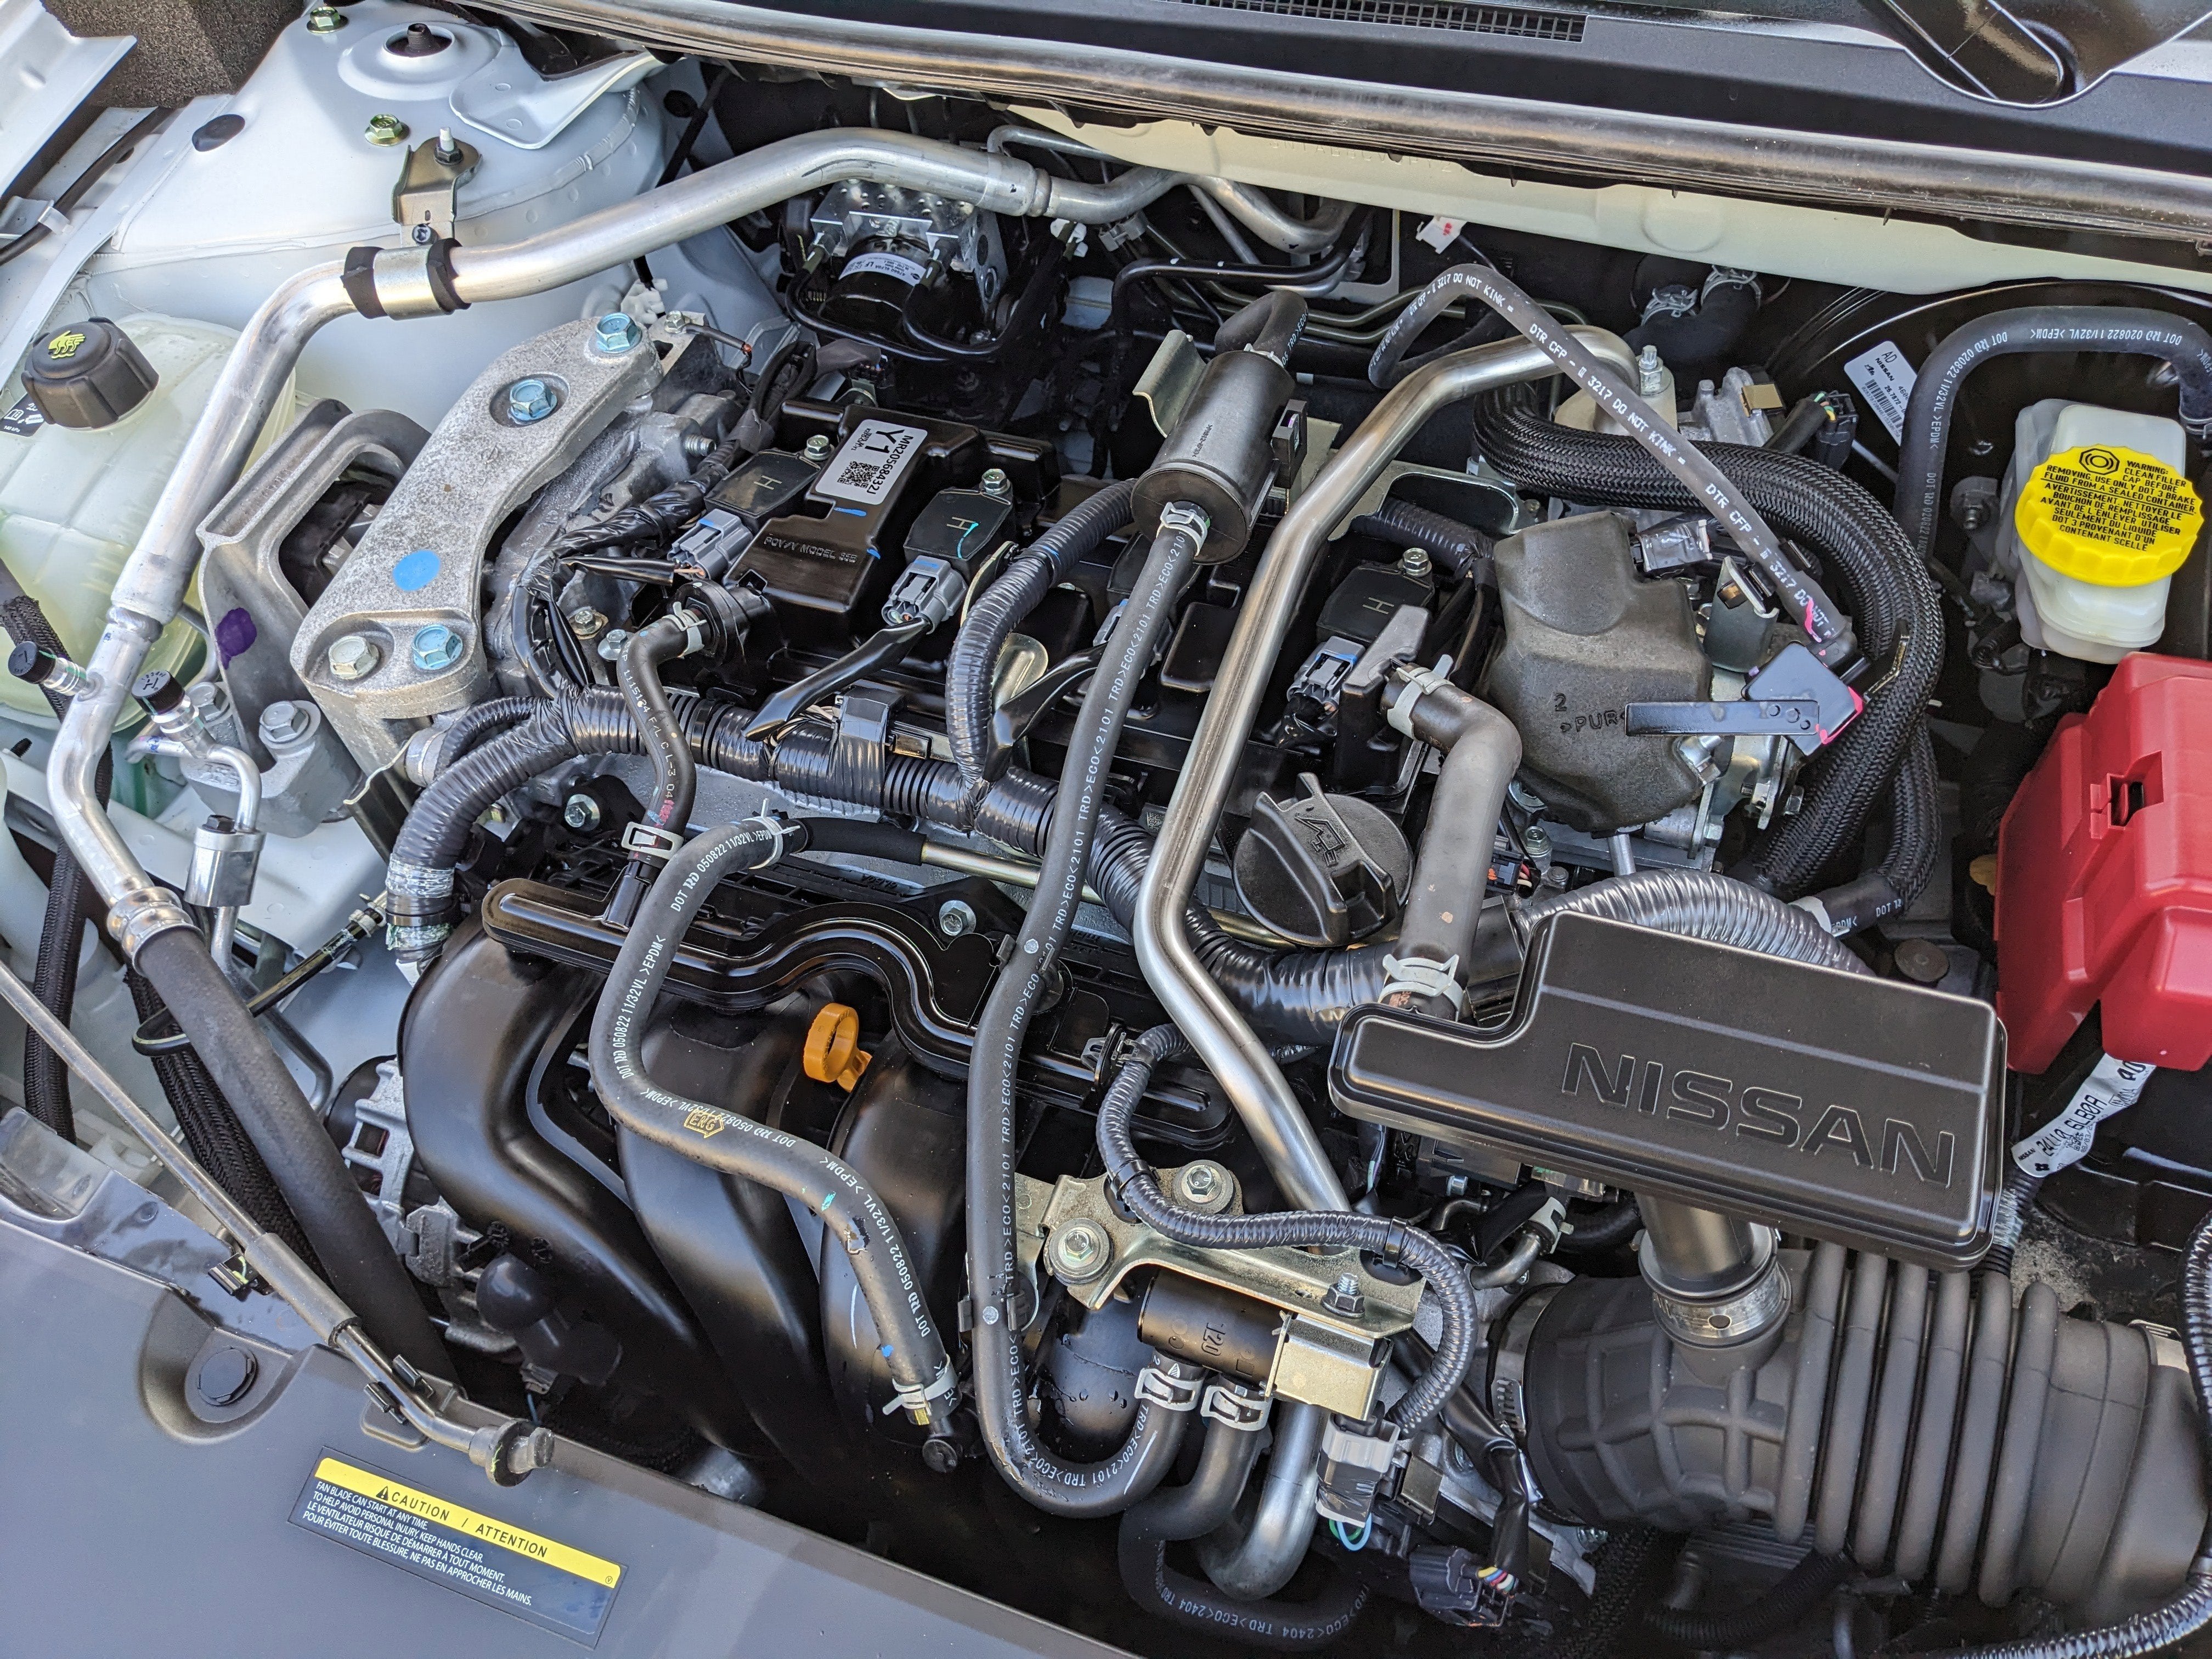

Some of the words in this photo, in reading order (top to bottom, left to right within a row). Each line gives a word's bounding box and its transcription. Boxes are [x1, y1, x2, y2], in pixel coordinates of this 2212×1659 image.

[1437, 274, 1451, 289] 3217
[1453, 273, 1463, 283] DO
[1465, 275, 1482, 290] NOT
[1483, 285, 1505, 307] KINK
[1992, 332, 2007, 346] DOT
[2030, 329, 2064, 339] >EPDM<
[2107, 329, 2143, 340] 020822
[2163, 332, 2182, 346] DOT
[1875, 357, 1894, 381] NISSAN
[1881, 351, 1898, 364] AD
[1947, 349, 1974, 378] 020822
[1530, 324, 1548, 343] DTR
[1549, 341, 1567, 358] CFP
[1588, 376, 1613, 400] 3217
[1612, 398, 1627, 414] DO
[1627, 412, 1649, 432] NOT
[1648, 430, 1676, 457] KINK
[864, 430, 904, 454] Y1
[1930, 415, 1942, 449] >EPDM<
[866, 435, 914, 496] MR20568432J
[1926, 473, 1937, 489] DOT
[2124, 467, 2154, 481] CLEAN
[2155, 474, 2186, 488] FILLER
[2044, 472, 2069, 483] FLUID
[2072, 478, 2096, 490] FROM
[2108, 487, 2143, 501] SEALED
[2145, 495, 2198, 514] CONTAINER.
[2095, 476, 2112, 486] USE
[2112, 479, 2135, 491] ONLY
[2137, 486, 2155, 496] DOT
[2165, 492, 2195, 505] BRAKE
[2122, 475, 2140, 484] CAP
[2145, 479, 2178, 493] BEFORE
[2040, 496, 2070, 509] AVANT
[2074, 504, 2085, 512] DE
[2087, 507, 2136, 524] L'ENLEVER
[2141, 520, 2181, 535] UTILISER
[2052, 492, 2092, 506] BOUCHON
[2094, 501, 2105, 510] DE
[2107, 504, 2170, 525] REMPLISSAGE
[2053, 507, 2106, 525] SEULEMENT
[2109, 520, 2121, 528] DU
[2123, 523, 2157, 537] LIQUIDE
[2123, 500, 2168, 517] NETTOYER
[2170, 511, 2182, 521] LE
[1705, 483, 1729, 509] DTR
[1729, 510, 1752, 532] CFP
[1769, 560, 1797, 588] 3217
[2052, 514, 2069, 524] DOT
[2079, 521, 2132, 539] PROVENANT
[2134, 534, 2155, 545] D'UN
[2058, 524, 2111, 543] CONTENANT
[2113, 535, 2148, 551] SCELLÉ
[799, 543, 837, 559] MODEL
[1146, 530, 1187, 610] TRD>ECO<2101
[1109, 614, 1151, 706] TRD>ECO<2101
[1555, 693, 1567, 709] 2
[1078, 708, 1114, 821] TRD>ECO<2101
[671, 890, 688, 912] DOT
[697, 844, 727, 872] 050822
[725, 832, 754, 849] 11/32VL
[1052, 831, 1085, 932] TRD>ECO<2101
[1875, 902, 1891, 917] DOT
[640, 935, 666, 975] >EPDM<
[621, 979, 647, 1014] 11/32VL
[613, 1015, 630, 1048] 050822
[617, 1064, 634, 1079] DOT
[640, 1088, 678, 1108] >EPDM<
[1001, 1036, 1015, 1143] TRD>ECO<2101
[689, 1114, 718, 1131] ENG
[1561, 1042, 1959, 1188] NISSAN
[772, 1134, 797, 1148] DOT
[2018, 1148, 2036, 1161] NISSAN
[820, 1156, 865, 1195] >EPDM<
[863, 1194, 896, 1244] 11/32VL
[1002, 1153, 1014, 1286] TRD>ECO<2101
[889, 1244, 913, 1291] 050822
[915, 1313, 931, 1338] DOT
[1201, 1323, 1226, 1356] 120
[1092, 1404, 1149, 1485] TRD>ECO<2101
[316, 1481, 330, 1493] FAN
[330, 1486, 352, 1502] BLADE
[351, 1494, 367, 1507] CAN
[366, 1499, 387, 1515] START
[386, 1507, 397, 1518] AT
[396, 1510, 413, 1524] ANY
[411, 1516, 429, 1530] TIME.
[312, 1491, 323, 1502] TO
[322, 1494, 340, 1508] HELP
[338, 1500, 361, 1516] AVOID
[360, 1509, 395, 1529] PERSONAL
[394, 1521, 420, 1538] INJURY,
[419, 1531, 437, 1545] KEEP
[436, 1537, 461, 1554] HANDS
[460, 1547, 484, 1563] CLEAR.
[391, 1491, 449, 1521] CAUTION
[475, 1522, 548, 1558] ATTENTION
[302, 1510, 324, 1526] POUR
[324, 1517, 348, 1534] ÉVITER
[348, 1528, 373, 1544] TOUTE
[373, 1537, 410, 1558] BLESSURE,
[409, 1551, 421, 1562] NE
[421, 1555, 436, 1568] PAS
[435, 1561, 447, 1572] EN
[447, 1565, 492, 1590] APPROCHER
[492, 1582, 506, 1595] LES
[506, 1588, 533, 1605] MAINS.
[307, 1500, 317, 1511] LE
[317, 1504, 364, 1529] VENTILATEUR
[363, 1522, 391, 1539] RISQUE
[390, 1532, 402, 1544] DE
[402, 1534, 443, 1559] DÉMARRER
[442, 1549, 449, 1561] À
[448, 1554, 470, 1570] TOUT
[469, 1562, 505, 1583] MOMENT.
[1179, 1598, 1272, 1635] TRD>ECO<2404
